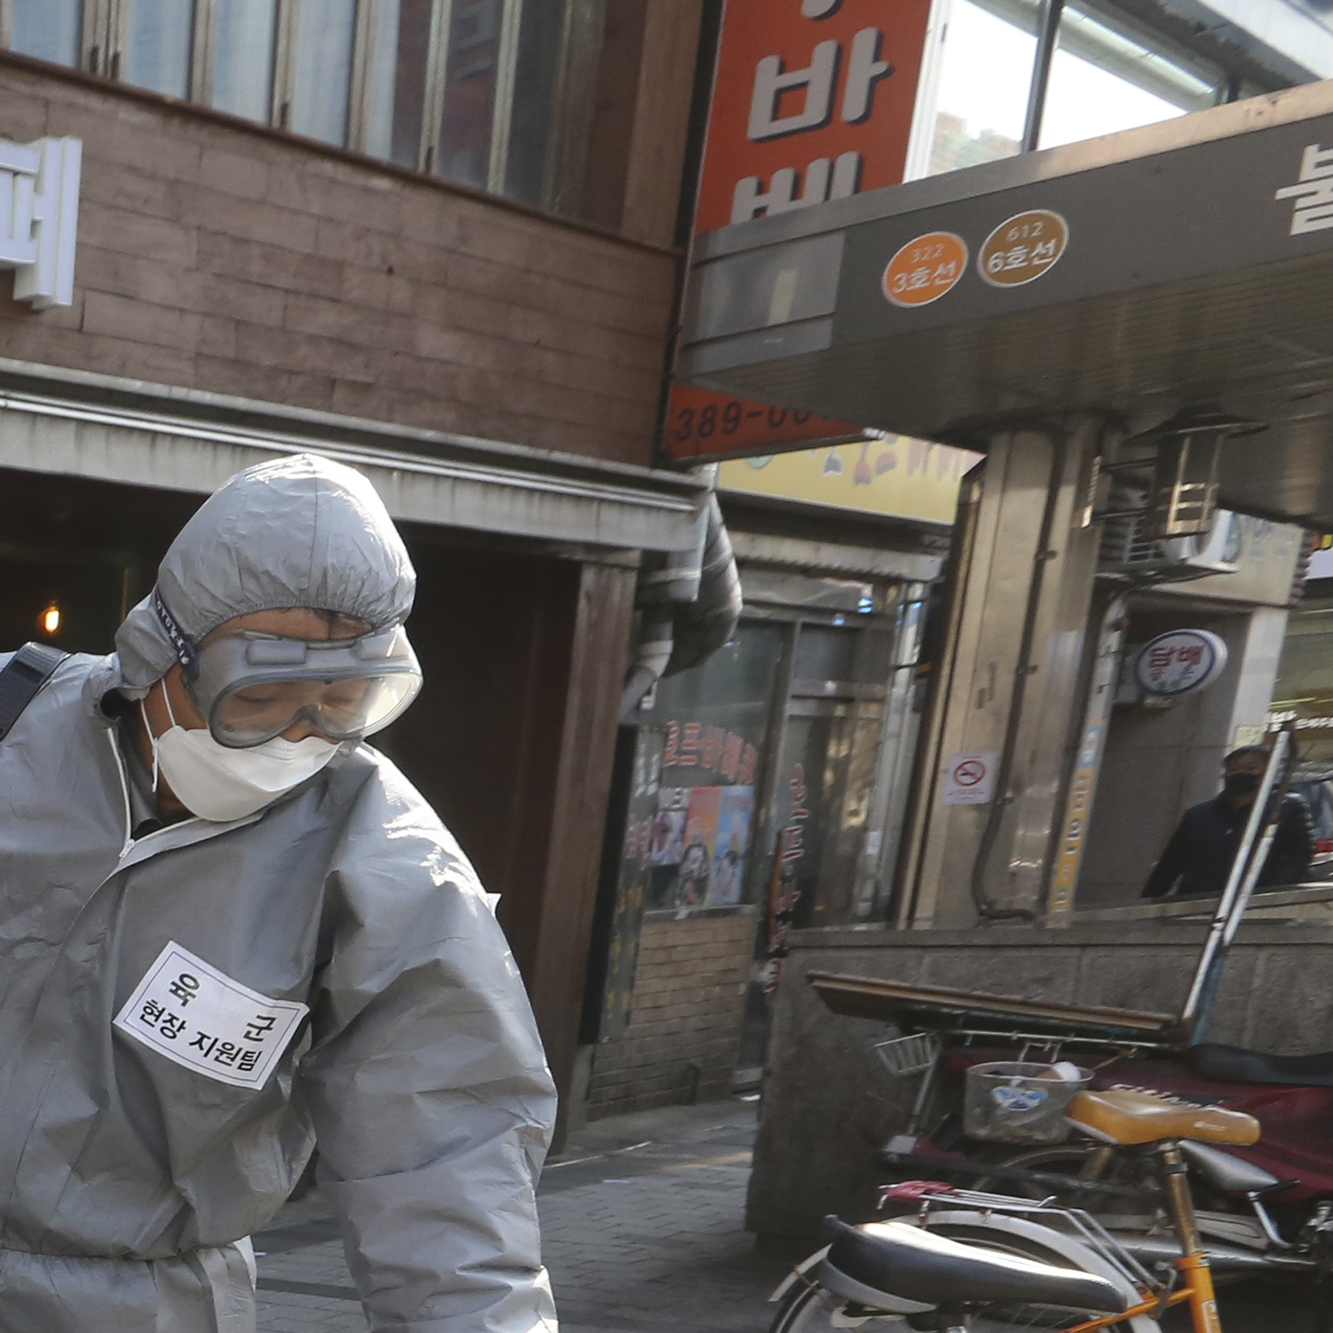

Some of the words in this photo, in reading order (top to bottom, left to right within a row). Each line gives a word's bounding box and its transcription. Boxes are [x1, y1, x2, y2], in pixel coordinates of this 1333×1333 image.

[1006, 221, 1045, 243] 612
[911, 243, 946, 264] 322
[988, 238, 1057, 273] 6호선
[893, 261, 958, 294] 3호선
[169, 973, 201, 1007] 육
[243, 1014, 278, 1042] 군
[139, 999, 187, 1040] 현장
[189, 1031, 263, 1072] 지원팀
